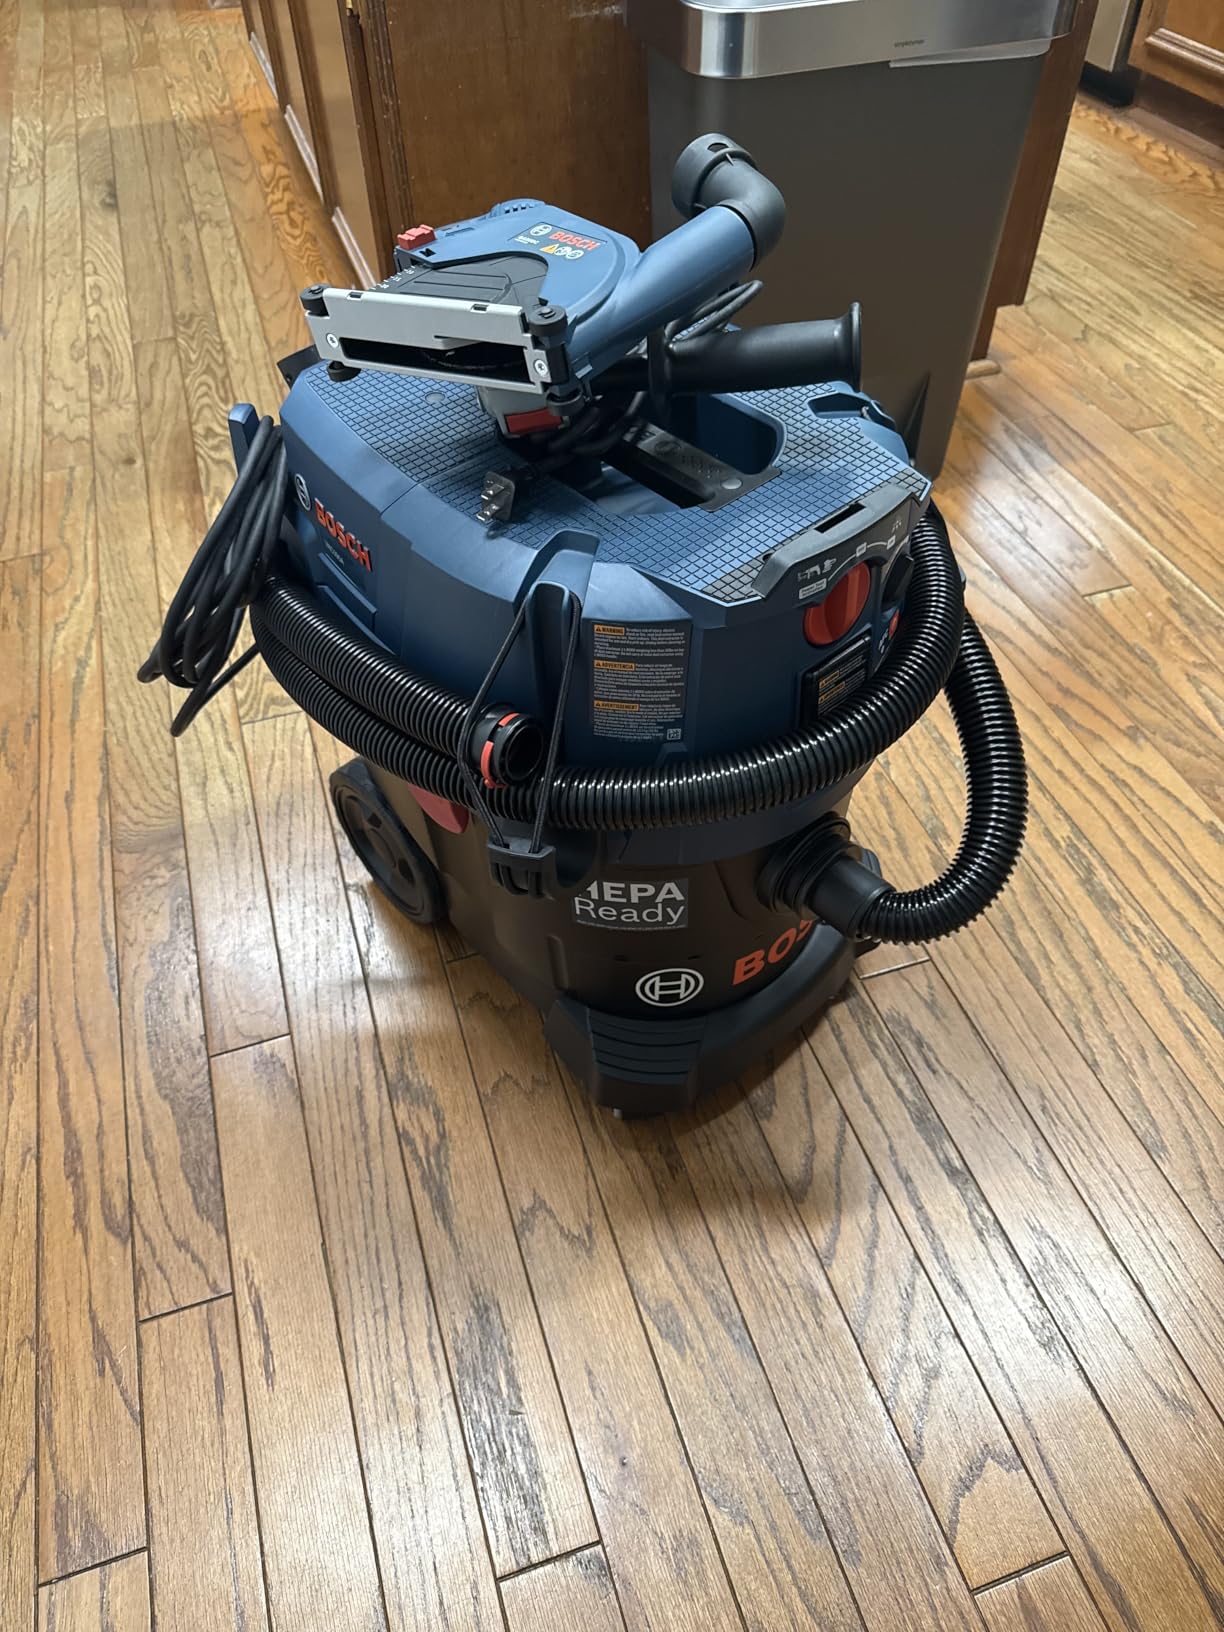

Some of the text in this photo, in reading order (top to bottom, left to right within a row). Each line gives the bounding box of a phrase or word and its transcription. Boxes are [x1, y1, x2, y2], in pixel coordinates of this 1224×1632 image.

[549, 231, 601, 251] BOSCH
[314, 497, 373, 572] BOSCH
[573, 897, 685, 925] Ready
